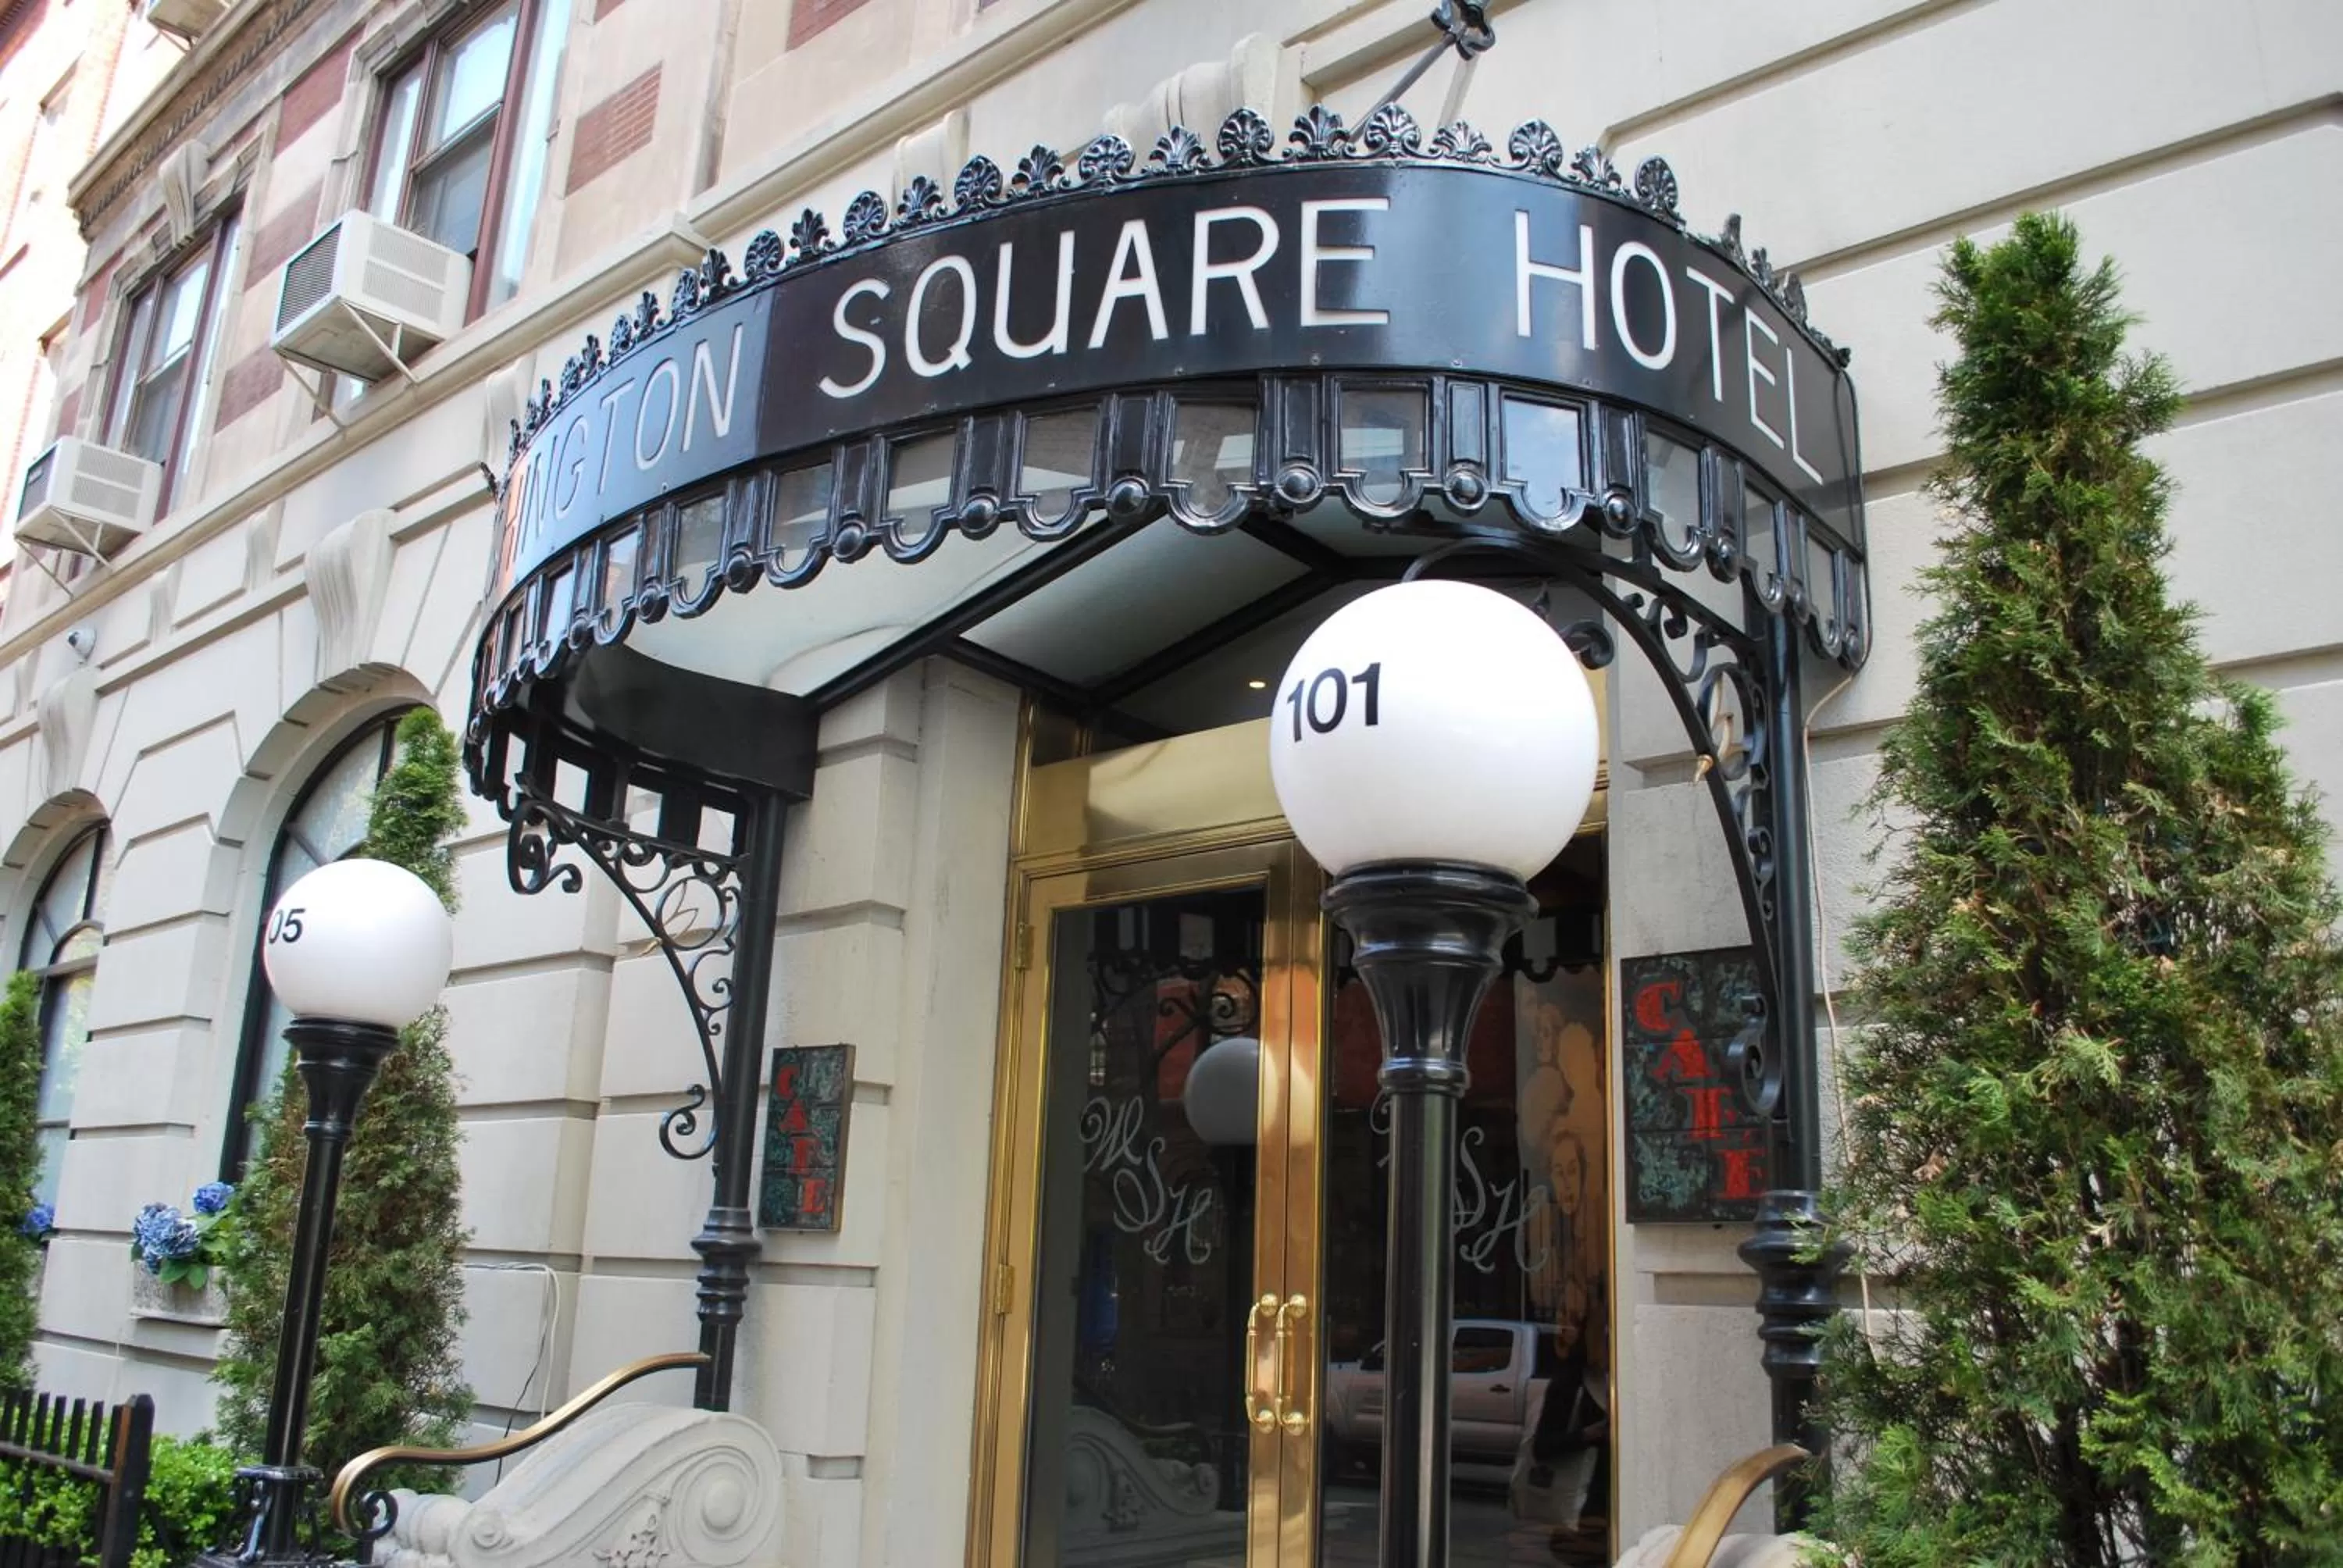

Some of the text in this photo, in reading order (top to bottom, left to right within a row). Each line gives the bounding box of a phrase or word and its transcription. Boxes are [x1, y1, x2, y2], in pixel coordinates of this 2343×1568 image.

[818, 197, 1390, 399] SQUARE
[1515, 209, 1824, 486] HOTEL
[1287, 662, 1381, 743] 101
